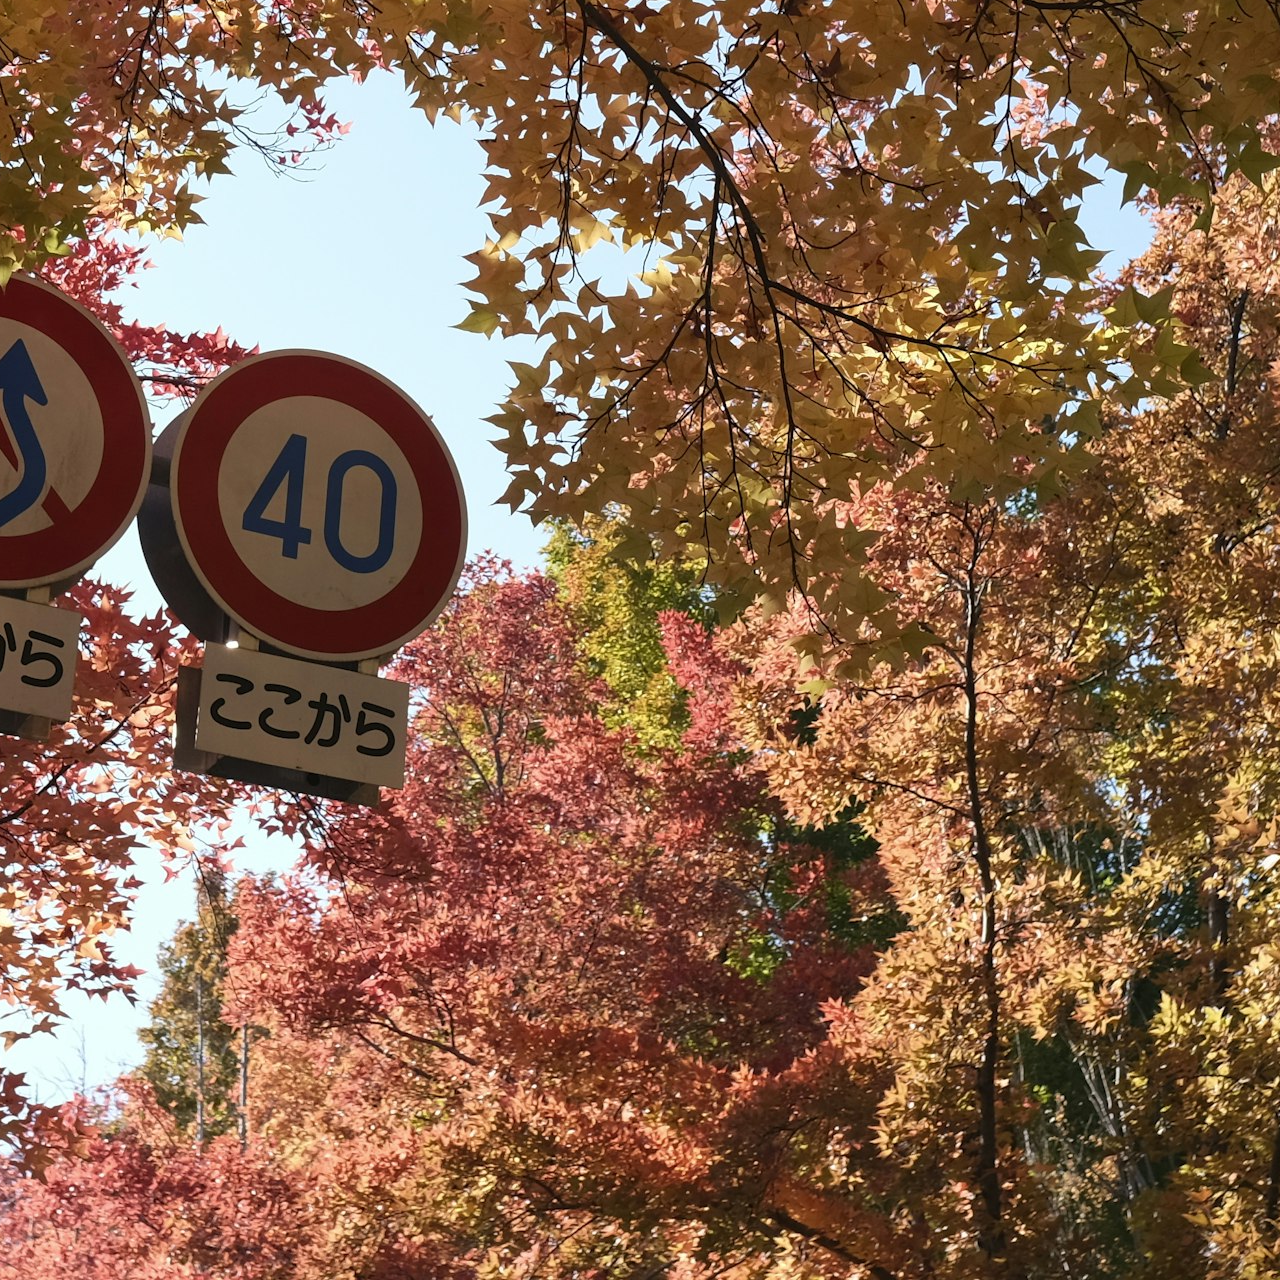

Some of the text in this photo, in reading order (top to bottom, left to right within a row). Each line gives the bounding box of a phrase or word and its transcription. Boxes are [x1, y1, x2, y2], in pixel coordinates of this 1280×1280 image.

[242, 433, 397, 574] 40
[210, 673, 395, 757] ここから
